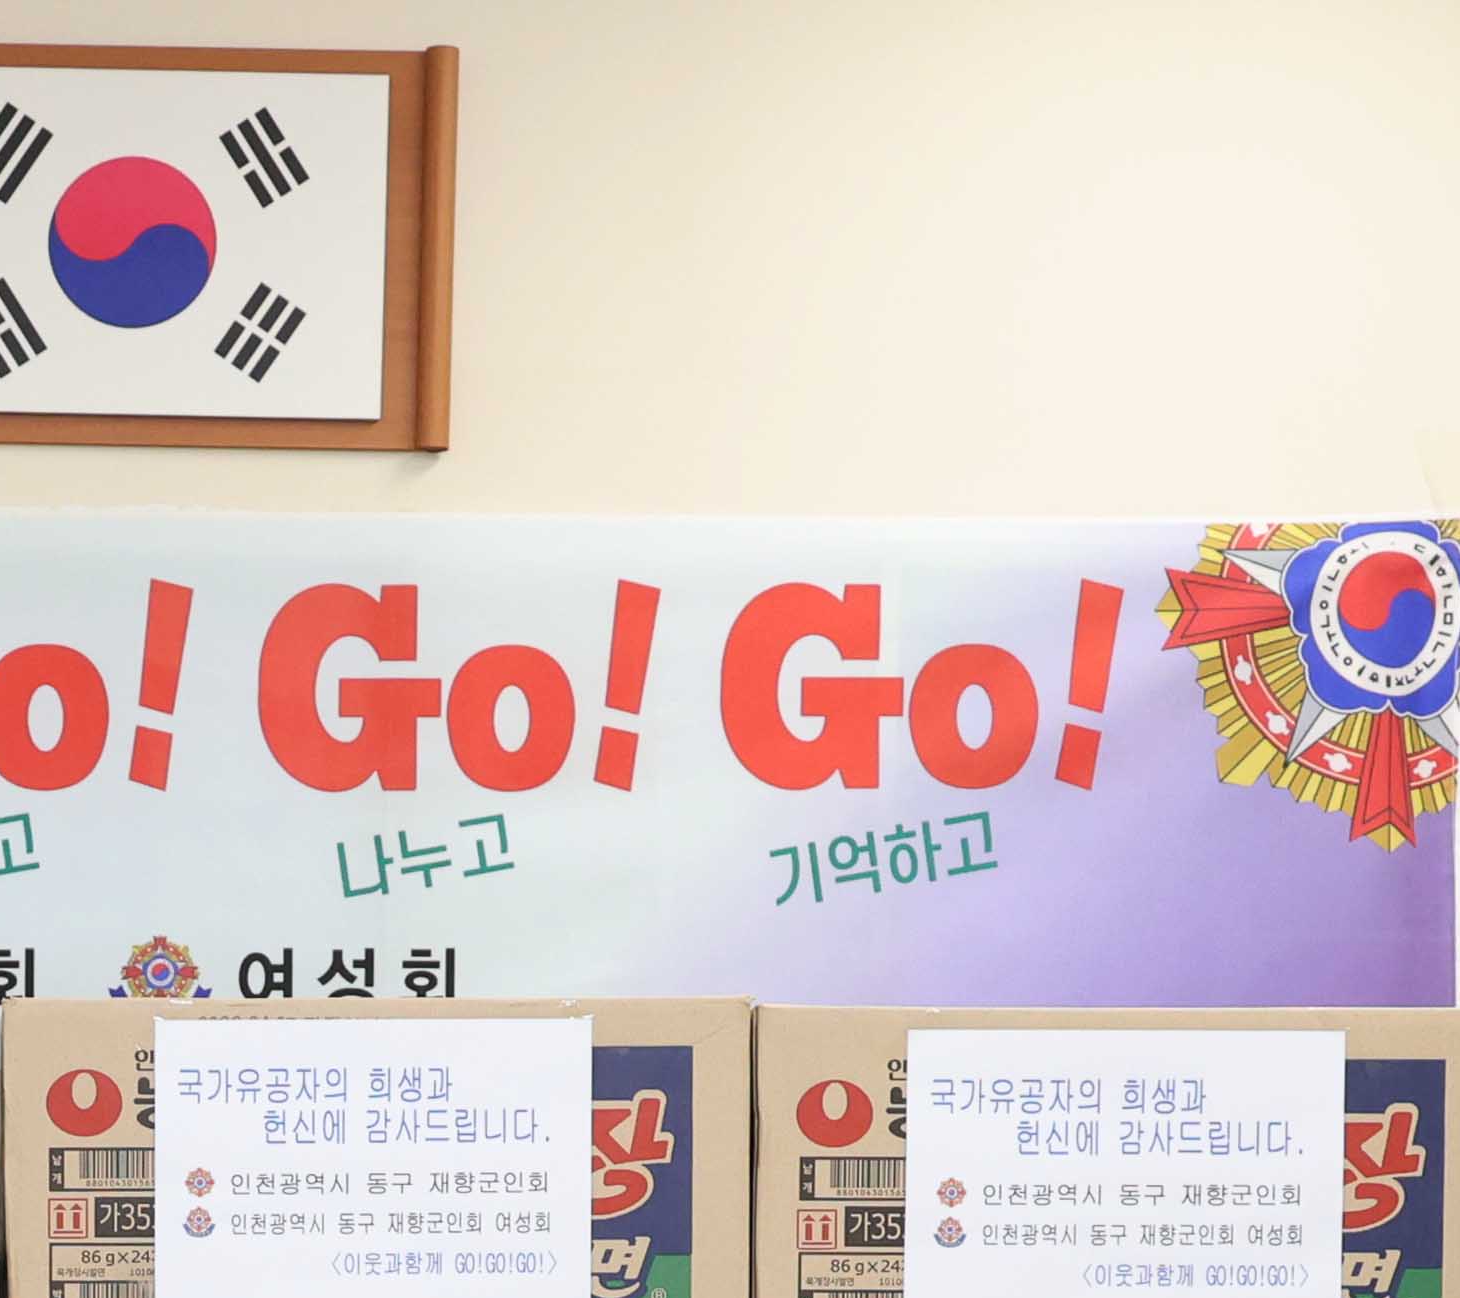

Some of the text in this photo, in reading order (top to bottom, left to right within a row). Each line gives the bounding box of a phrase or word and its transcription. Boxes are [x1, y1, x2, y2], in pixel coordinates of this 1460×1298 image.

[259, 577, 661, 793] Go!
[720, 577, 1123, 793] Go!
[337, 815, 516, 898] 나누고
[769, 812, 1000, 907] 기억하고
[179, 1068, 452, 1103] 국가유공자의 희생과
[932, 1079, 1206, 1114] 국가유공자의 희생과
[264, 1109, 549, 1144] 헌신에 감사드립니다.
[1018, 1121, 1302, 1155] 헌신에 감사드립니다.
[231, 1172, 547, 1195] 인천광역시 동구 재향군인회
[983, 1185, 1300, 1206] 인천광역시 동구 재향군인회
[100, 1201, 154, 1232] 가35
[232, 1213, 550, 1235] 인천광역시 동구 재향군인회 여성회
[849, 1211, 903, 1243] 가35
[983, 1225, 1301, 1246] 인천광역시 동구 재향군인회 여성회
